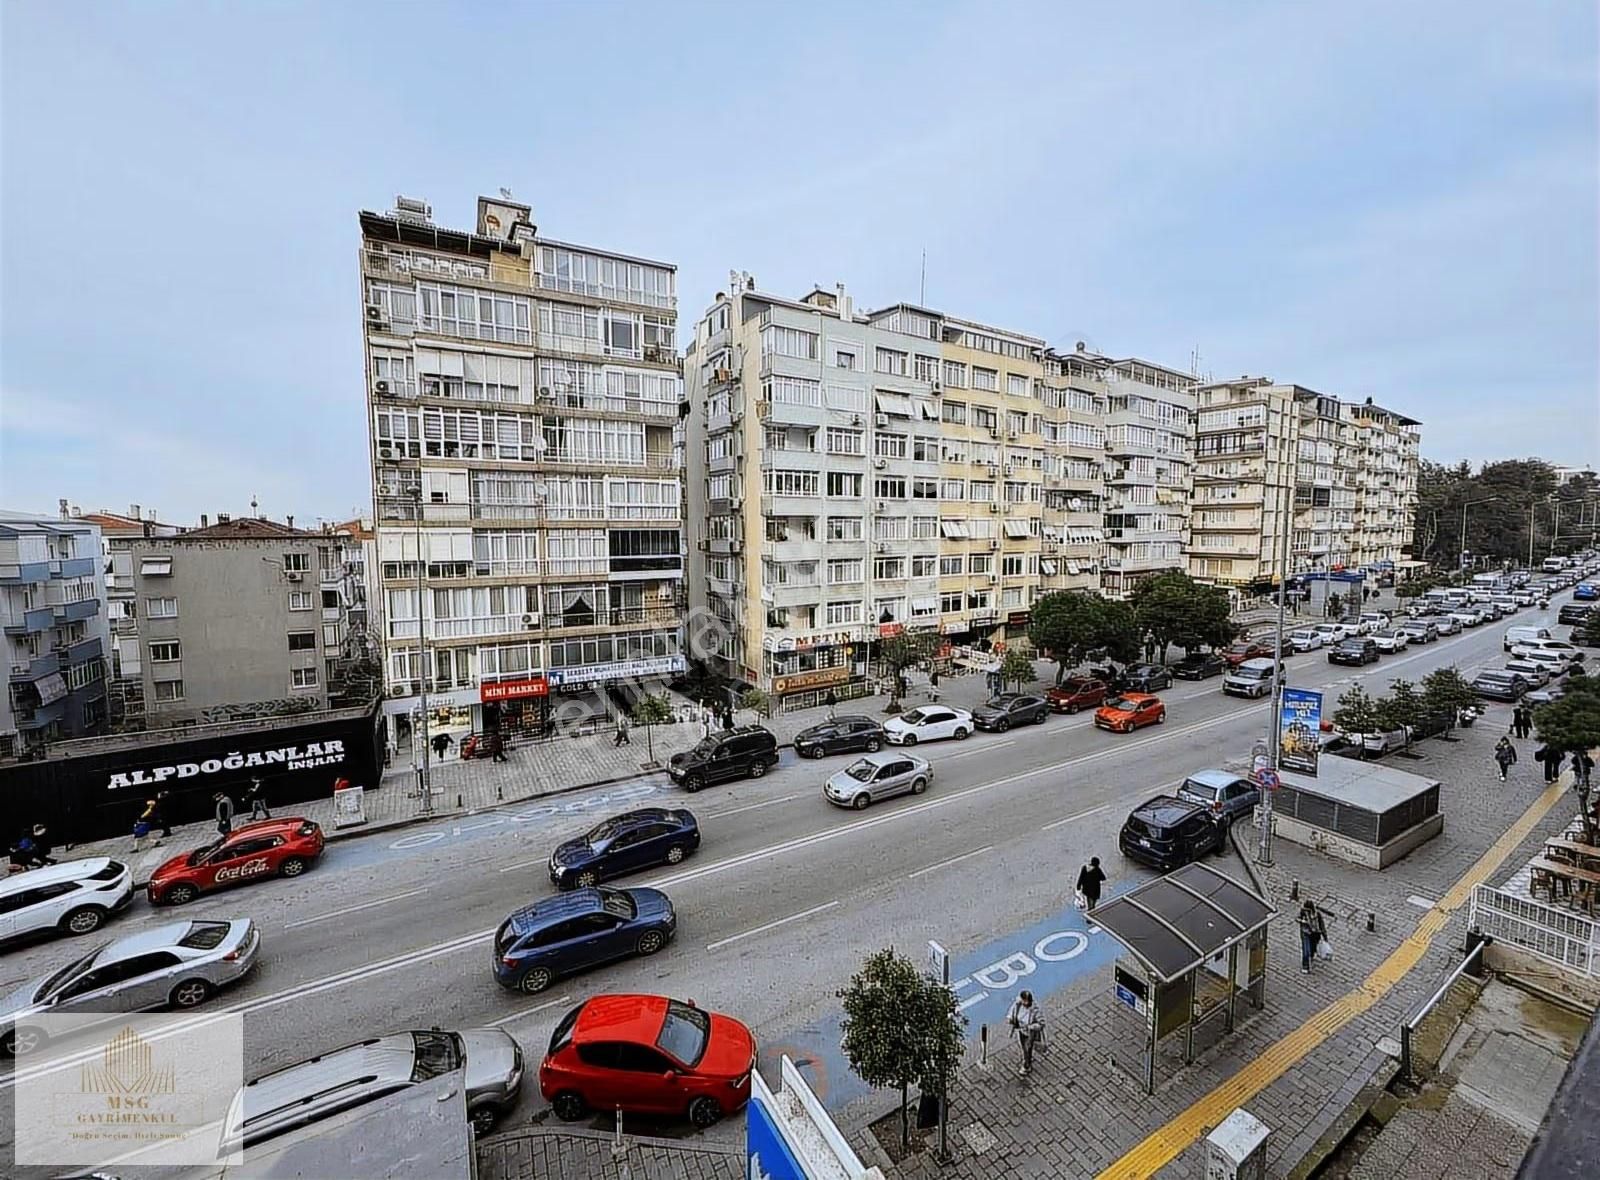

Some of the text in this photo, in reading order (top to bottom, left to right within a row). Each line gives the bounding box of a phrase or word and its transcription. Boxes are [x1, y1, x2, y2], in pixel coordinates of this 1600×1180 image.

[484, 683, 544, 698] MİNİ MARKET
[107, 740, 344, 790] ALPDOĞANLAR
[288, 753, 345, 771] İNŞAAT
